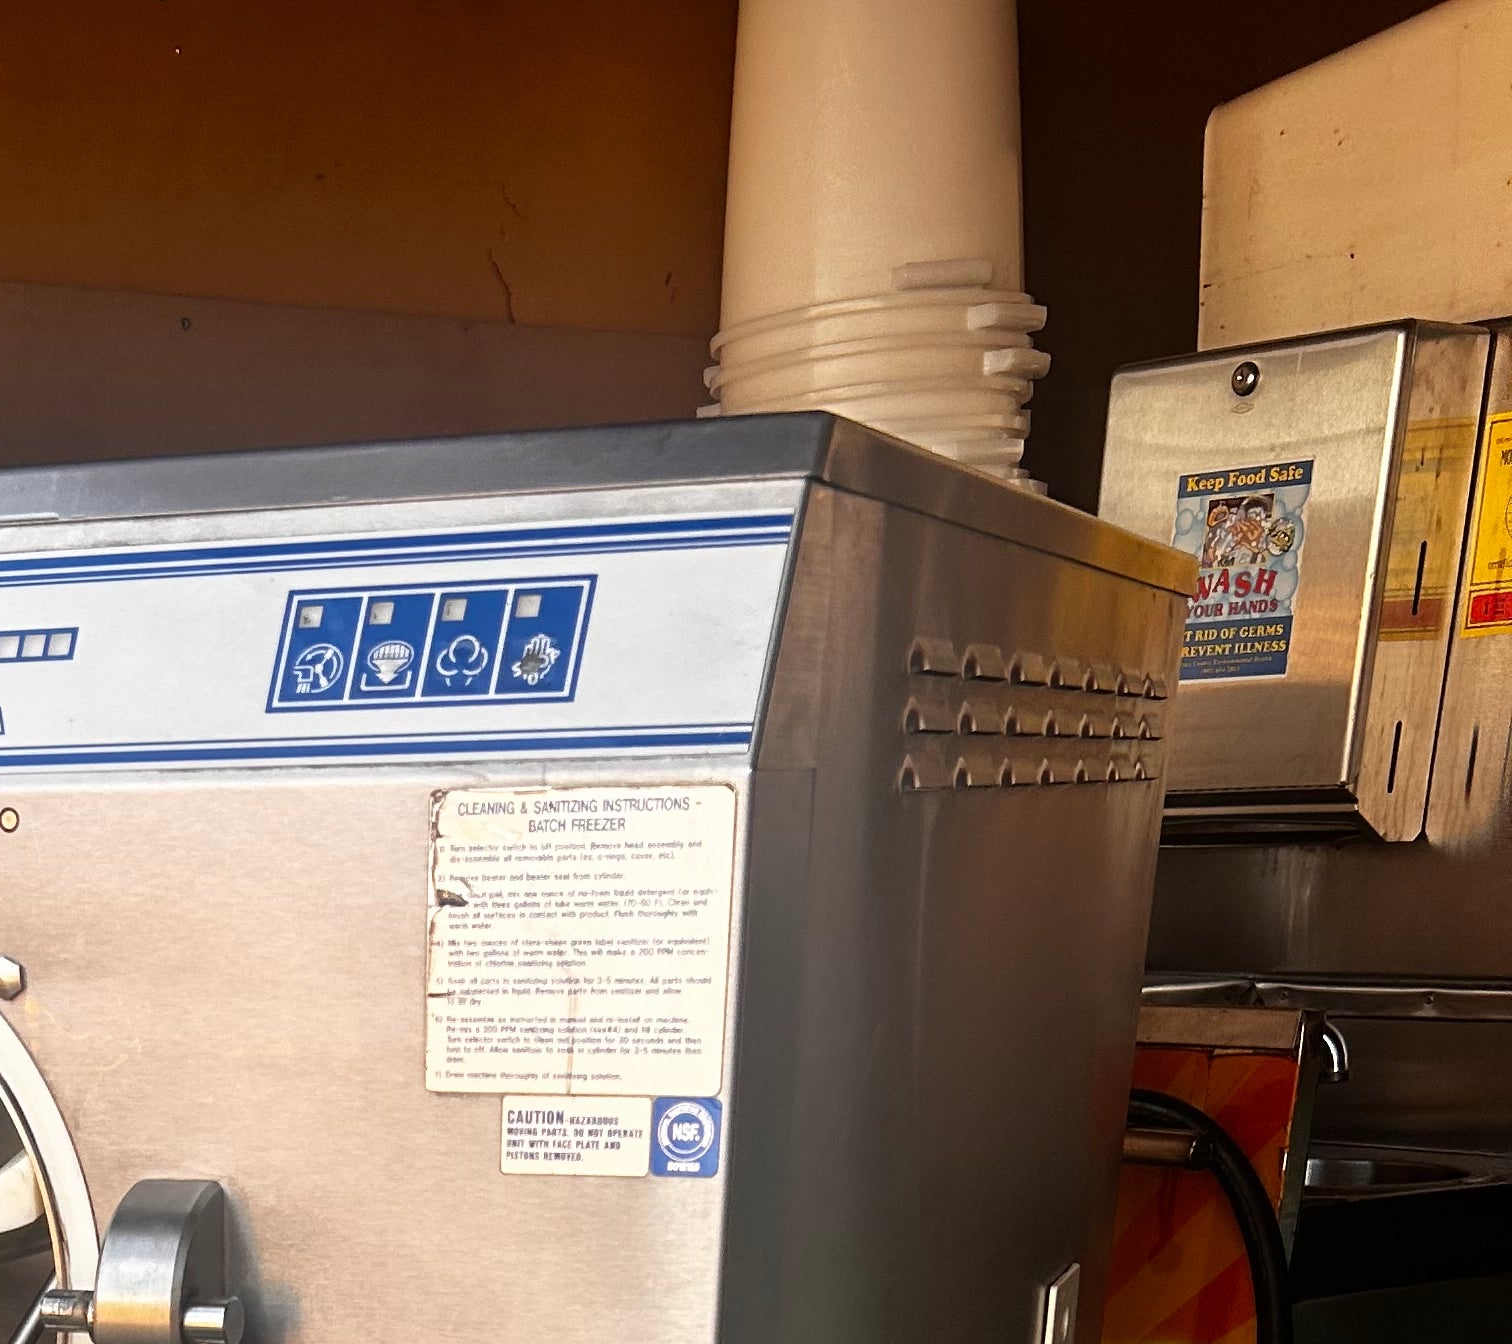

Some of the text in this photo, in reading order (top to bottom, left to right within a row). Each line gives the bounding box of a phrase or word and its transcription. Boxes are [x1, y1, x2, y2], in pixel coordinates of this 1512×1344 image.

[1186, 465, 1304, 493] Keep Food Safe
[1193, 567, 1278, 603] WASH
[1186, 598, 1279, 619] YOUR HANDS
[1183, 624, 1284, 642] T RID OF GERMS
[1180, 640, 1287, 658] REVENT ILLNESS
[458, 797, 690, 816] CLEANING & SANITIZING INSTRUCTIONS
[529, 817, 626, 833] BATCH FREEZER
[507, 1110, 564, 1125] CAUTION
[507, 1127, 538, 1137] MOVING
[574, 1128, 584, 1138] DO
[588, 1128, 604, 1138] NOT
[607, 1128, 644, 1139] OPERATE
[506, 1139, 621, 1151] UNIT WITH FACE PLATE AND
[505, 1150, 540, 1161] PISTONS
